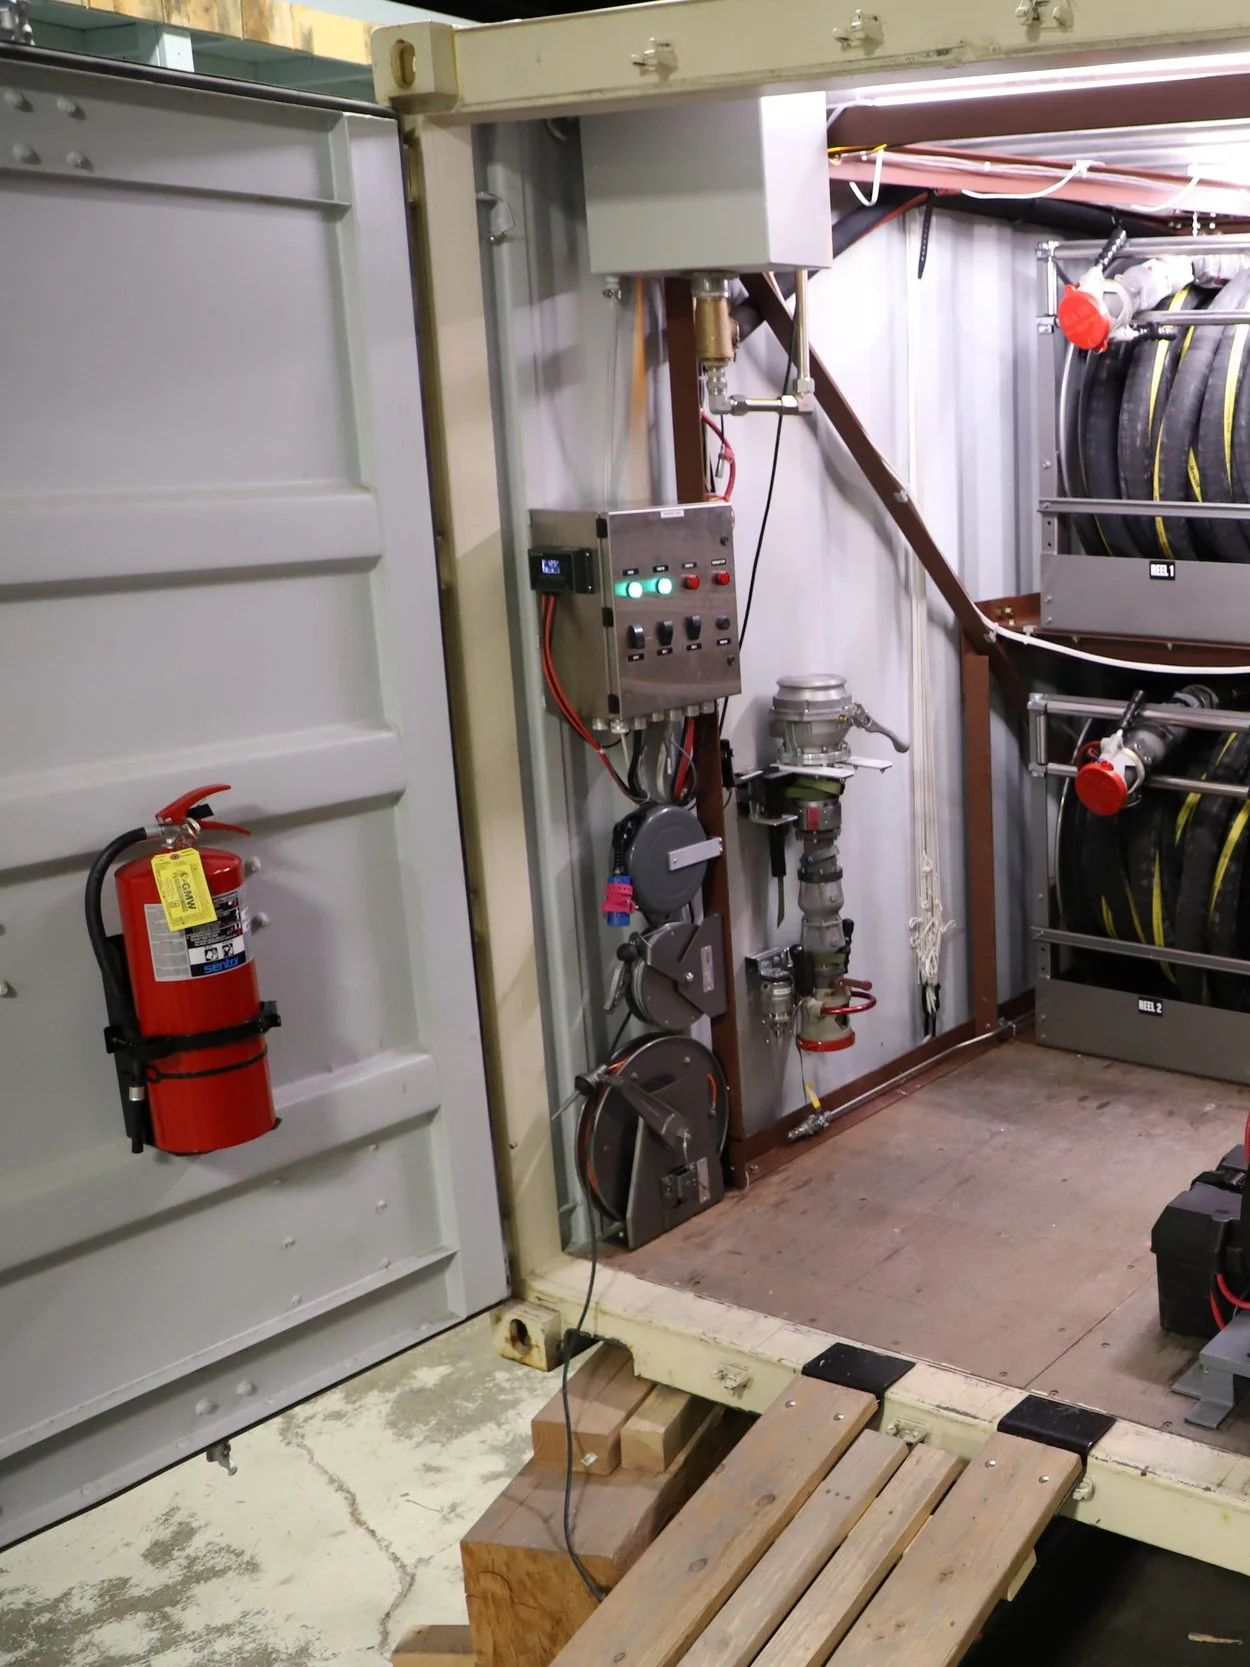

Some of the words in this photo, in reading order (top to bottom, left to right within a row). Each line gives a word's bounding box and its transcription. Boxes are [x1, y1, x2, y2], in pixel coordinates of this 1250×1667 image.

[1150, 564, 1169, 577] REEL
[1169, 564, 1174, 577] 1
[182, 882, 197, 910] GMW
[1138, 999, 1155, 1012] REEL
[1156, 1002, 1162, 1014] 2
